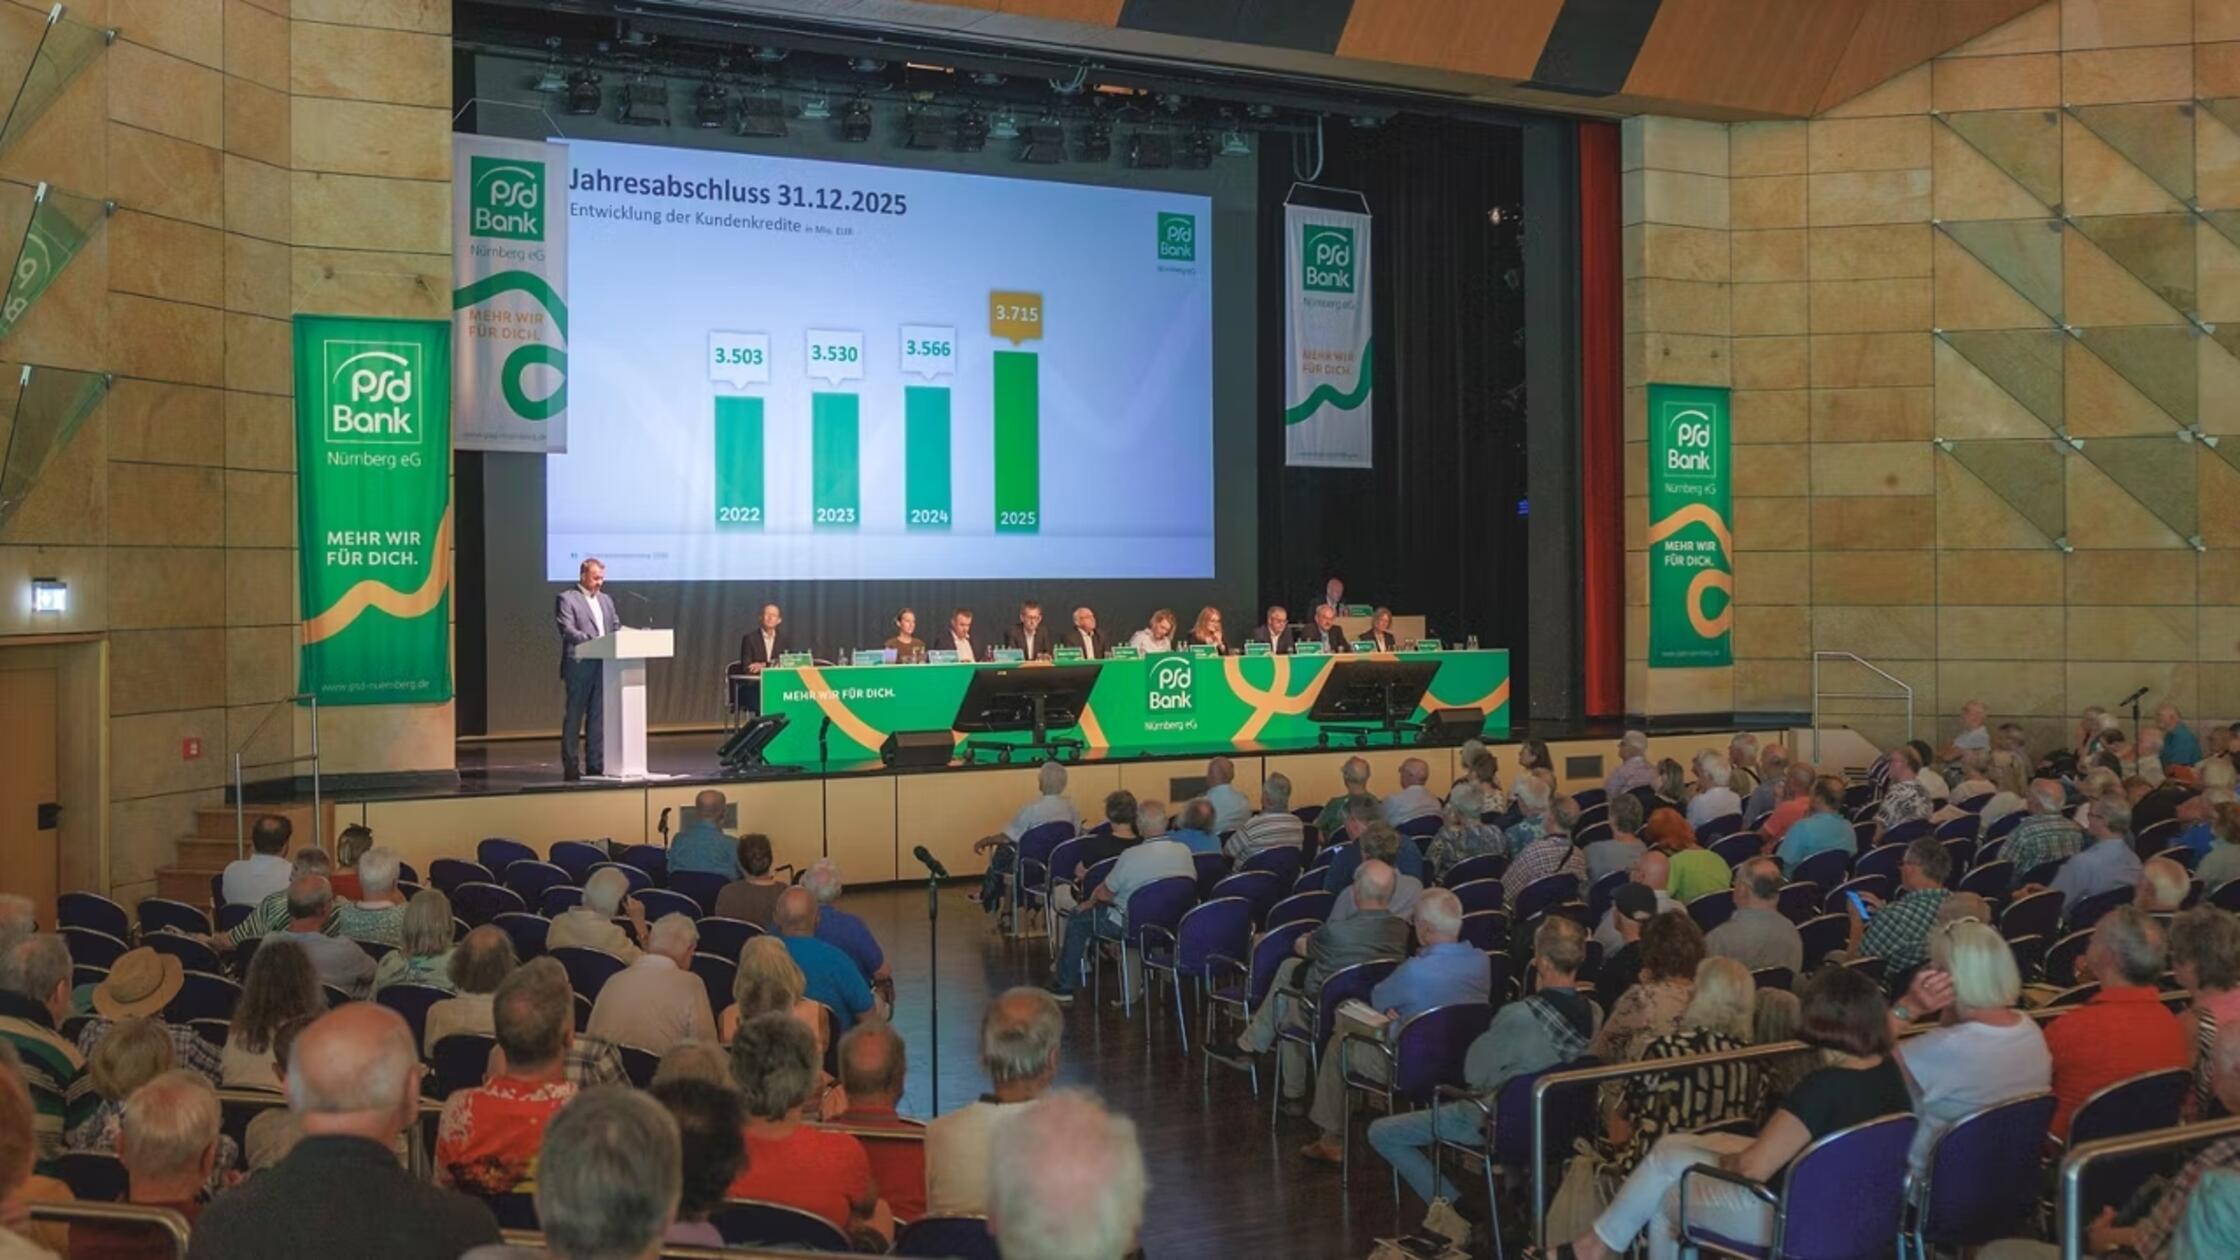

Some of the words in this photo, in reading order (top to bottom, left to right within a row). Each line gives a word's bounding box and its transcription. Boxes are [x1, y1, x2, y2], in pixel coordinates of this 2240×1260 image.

[569, 168, 770, 205] Jahresabschluss
[777, 184, 907, 216] 31.12.2025
[475, 208, 537, 234] Bank
[570, 202, 662, 225] Entwicklung
[666, 208, 690, 224] der
[696, 212, 801, 233] Kundenkredite
[470, 244, 525, 262] Nürnberg
[528, 248, 545, 262] eG
[1160, 241, 1192, 256] Bank
[1306, 266, 1350, 288] Bank
[468, 309, 512, 324] MEHR
[515, 311, 544, 325] WIR
[996, 304, 1039, 322] 3.715
[468, 323, 498, 339] FÜR
[501, 326, 541, 340] DICH.
[715, 348, 763, 365] 3.503
[811, 345, 858, 362] 3.530
[906, 339, 951, 357] 3.566
[333, 405, 413, 433] Bank
[327, 452, 396, 469] Nürnberg
[400, 453, 422, 467] eG
[1668, 449, 1710, 470] Bank
[720, 507, 760, 522] 2022
[817, 508, 855, 522] 2023
[911, 509, 948, 523] 2024
[1000, 511, 1036, 525] 2025
[327, 531, 381, 546] MEHR
[385, 531, 421, 546] WIR
[1665, 541, 1694, 552] MEHR
[1696, 541, 1716, 552] WIR
[327, 548, 362, 566] FÜR
[368, 551, 418, 566] DICH.
[1664, 553, 1684, 566] FÜR
[783, 689, 815, 701] MEHR
[842, 687, 864, 700] FÜR
[1150, 690, 1192, 709] Bank
